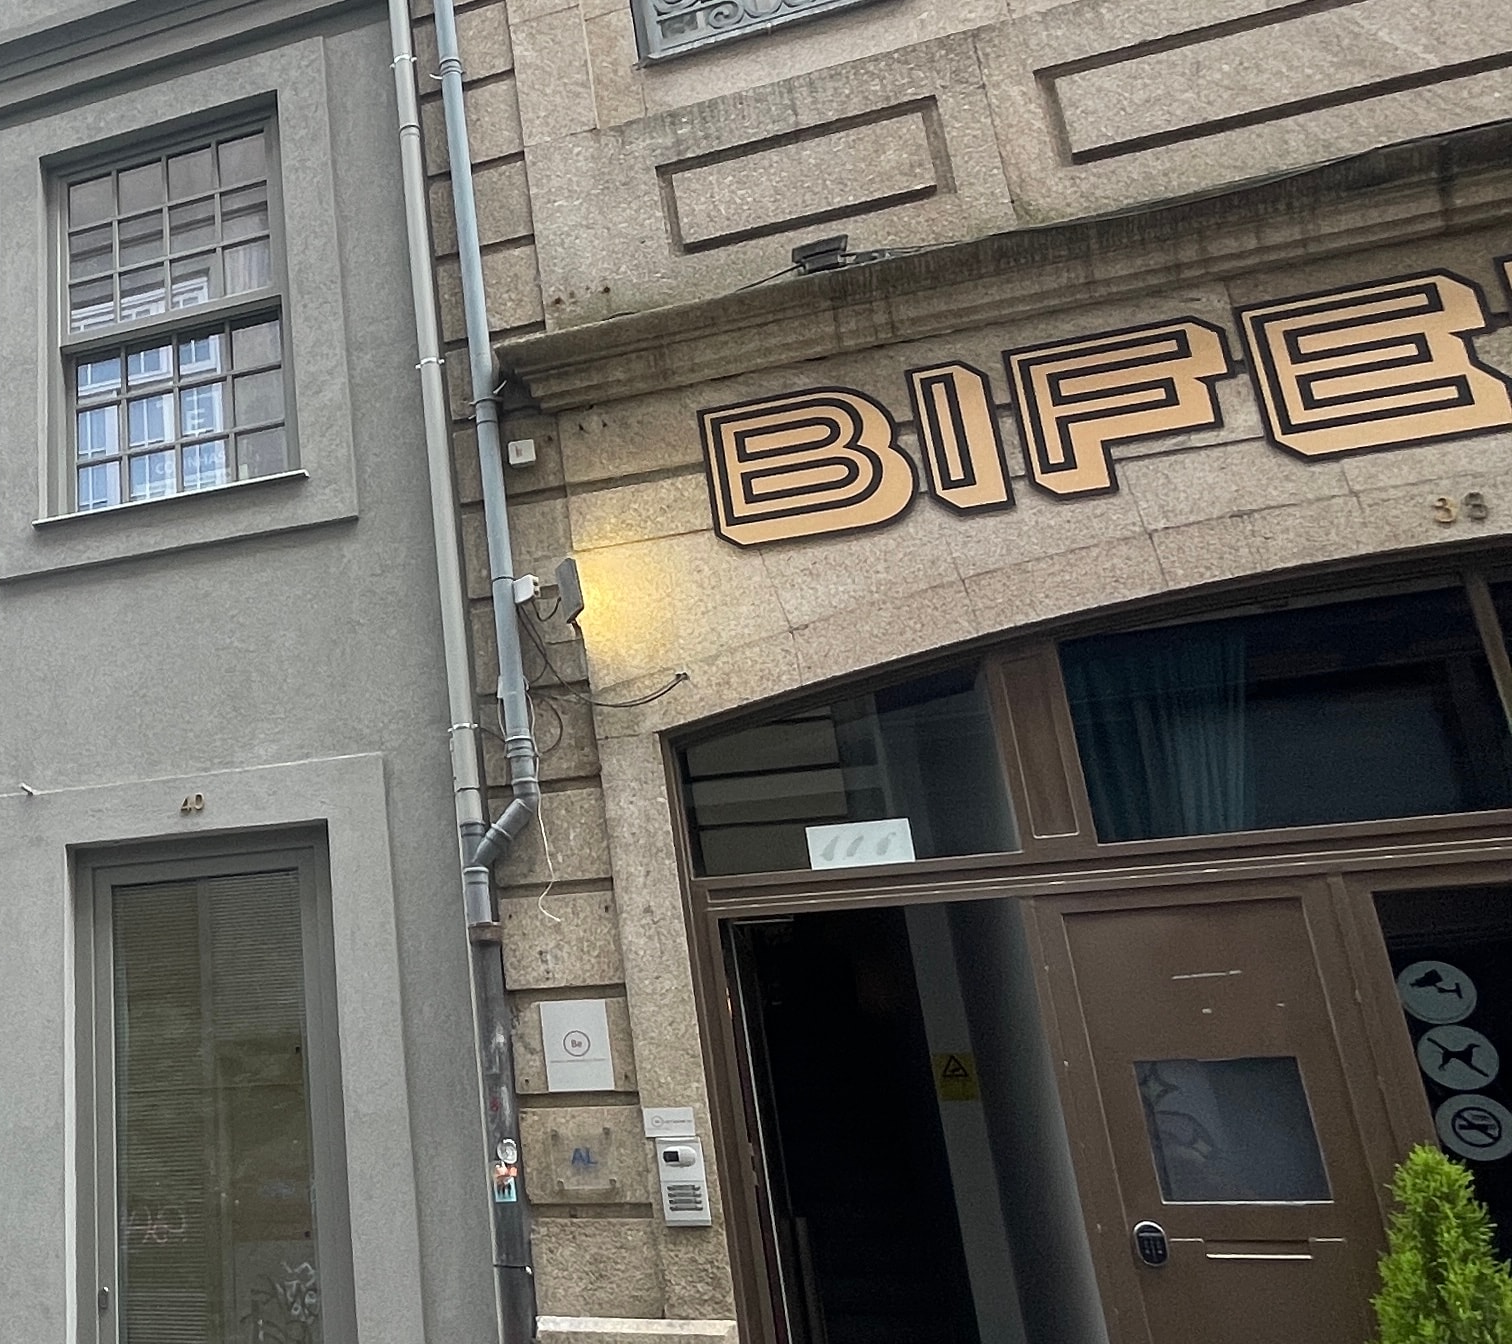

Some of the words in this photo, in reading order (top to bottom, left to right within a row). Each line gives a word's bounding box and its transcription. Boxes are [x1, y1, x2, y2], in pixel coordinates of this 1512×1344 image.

[696, 254, 1512, 550] BIFE
[180, 792, 205, 813] 40
[572, 1147, 598, 1164] AL
